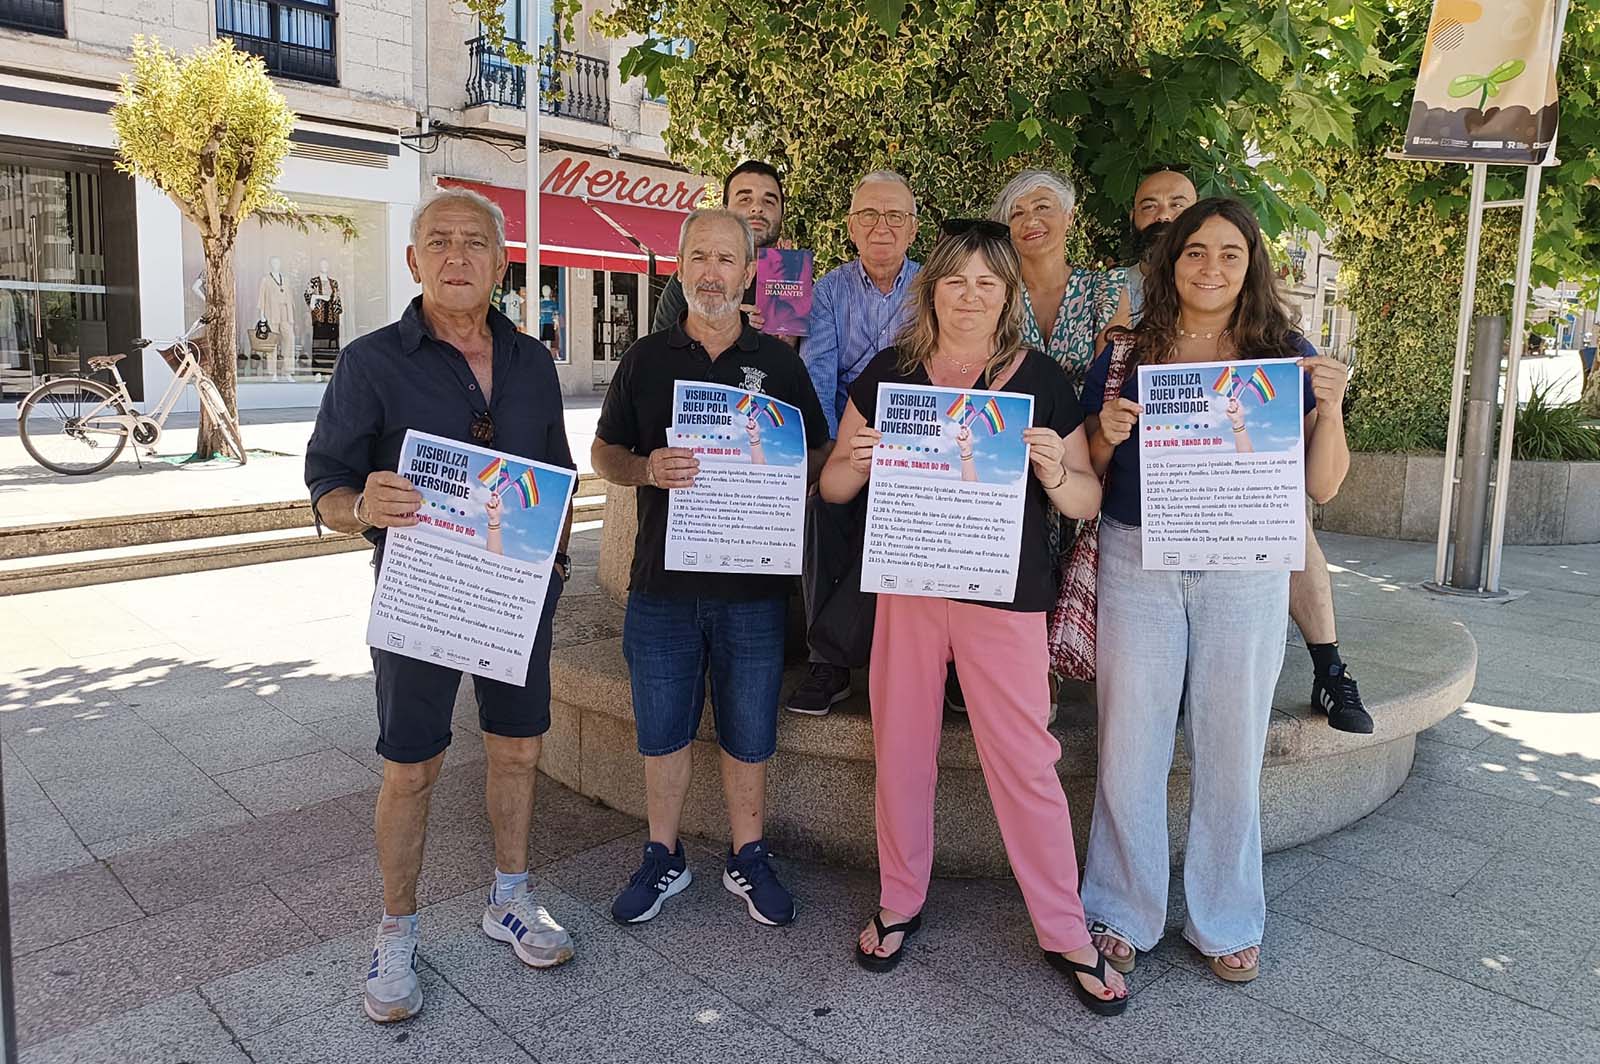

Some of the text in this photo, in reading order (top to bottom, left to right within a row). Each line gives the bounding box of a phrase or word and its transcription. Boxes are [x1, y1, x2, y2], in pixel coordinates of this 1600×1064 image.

[1152, 373, 1200, 386] VISIBILIZA
[686, 390, 727, 402] VISIBILIZA
[1150, 387, 1204, 400] BUEU POLA
[683, 402, 728, 413] BUEU POLA
[890, 394, 937, 408] VISIBILIZA
[1146, 401, 1208, 415] DIVERSIDADE
[678, 414, 732, 425] DIVERSIDADE
[887, 408, 937, 422] BUEU POLA
[881, 421, 941, 437] DIVERSIDADE
[416, 444, 469, 468] VISIBILIZA
[410, 458, 468, 483] BUEU POLA
[911, 461, 930, 470] BANDA
[940, 462, 950, 471] RÍO
[434, 518, 454, 530] BANDA
[455, 525, 464, 533] DO
[464, 526, 476, 536] RÍO
